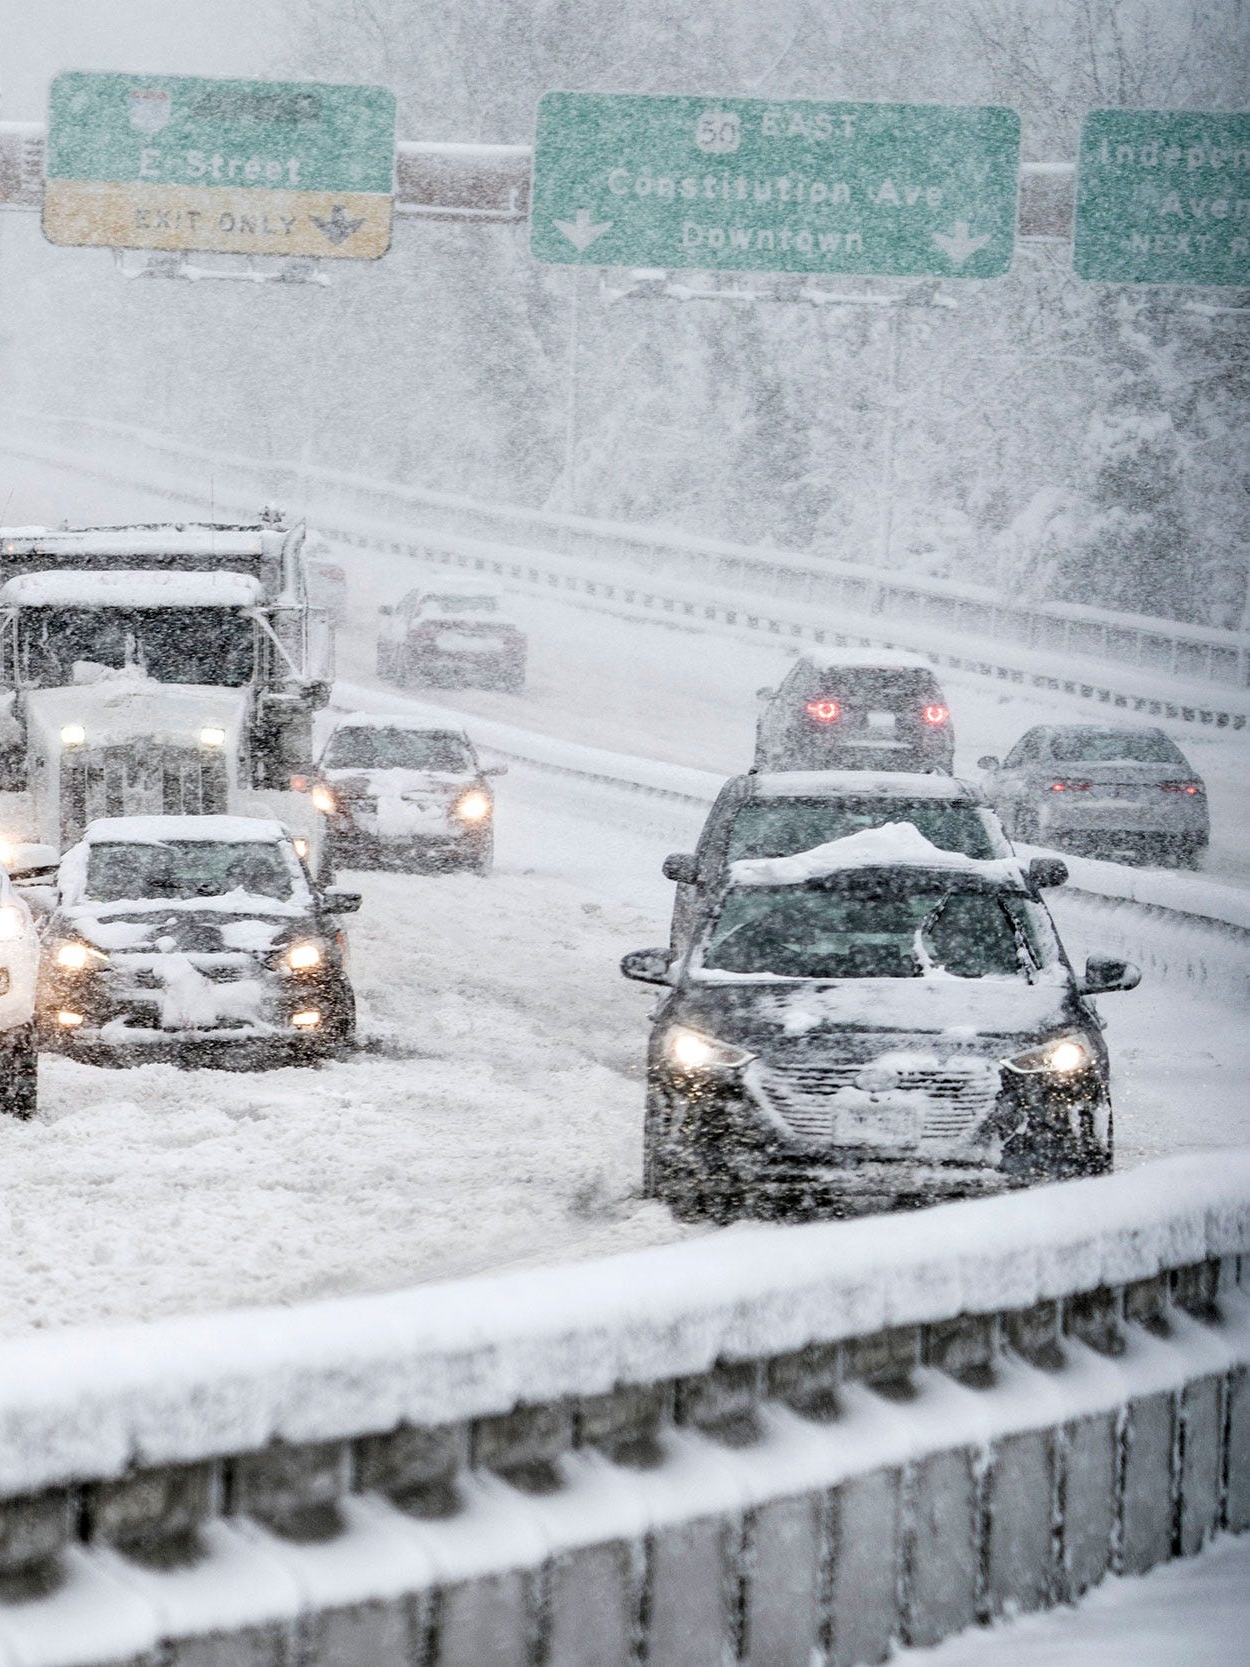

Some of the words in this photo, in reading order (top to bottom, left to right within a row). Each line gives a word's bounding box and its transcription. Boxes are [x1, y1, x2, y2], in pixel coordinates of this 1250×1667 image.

[700, 120, 736, 145] 50
[762, 112, 857, 139] EAST
[139, 148, 162, 177] E
[186, 150, 302, 185] Street
[608, 168, 850, 203] Constitution
[874, 178, 943, 207] Ave
[134, 208, 202, 231] EXIT
[218, 211, 298, 236] ONLY
[682, 221, 864, 251] Downtown
